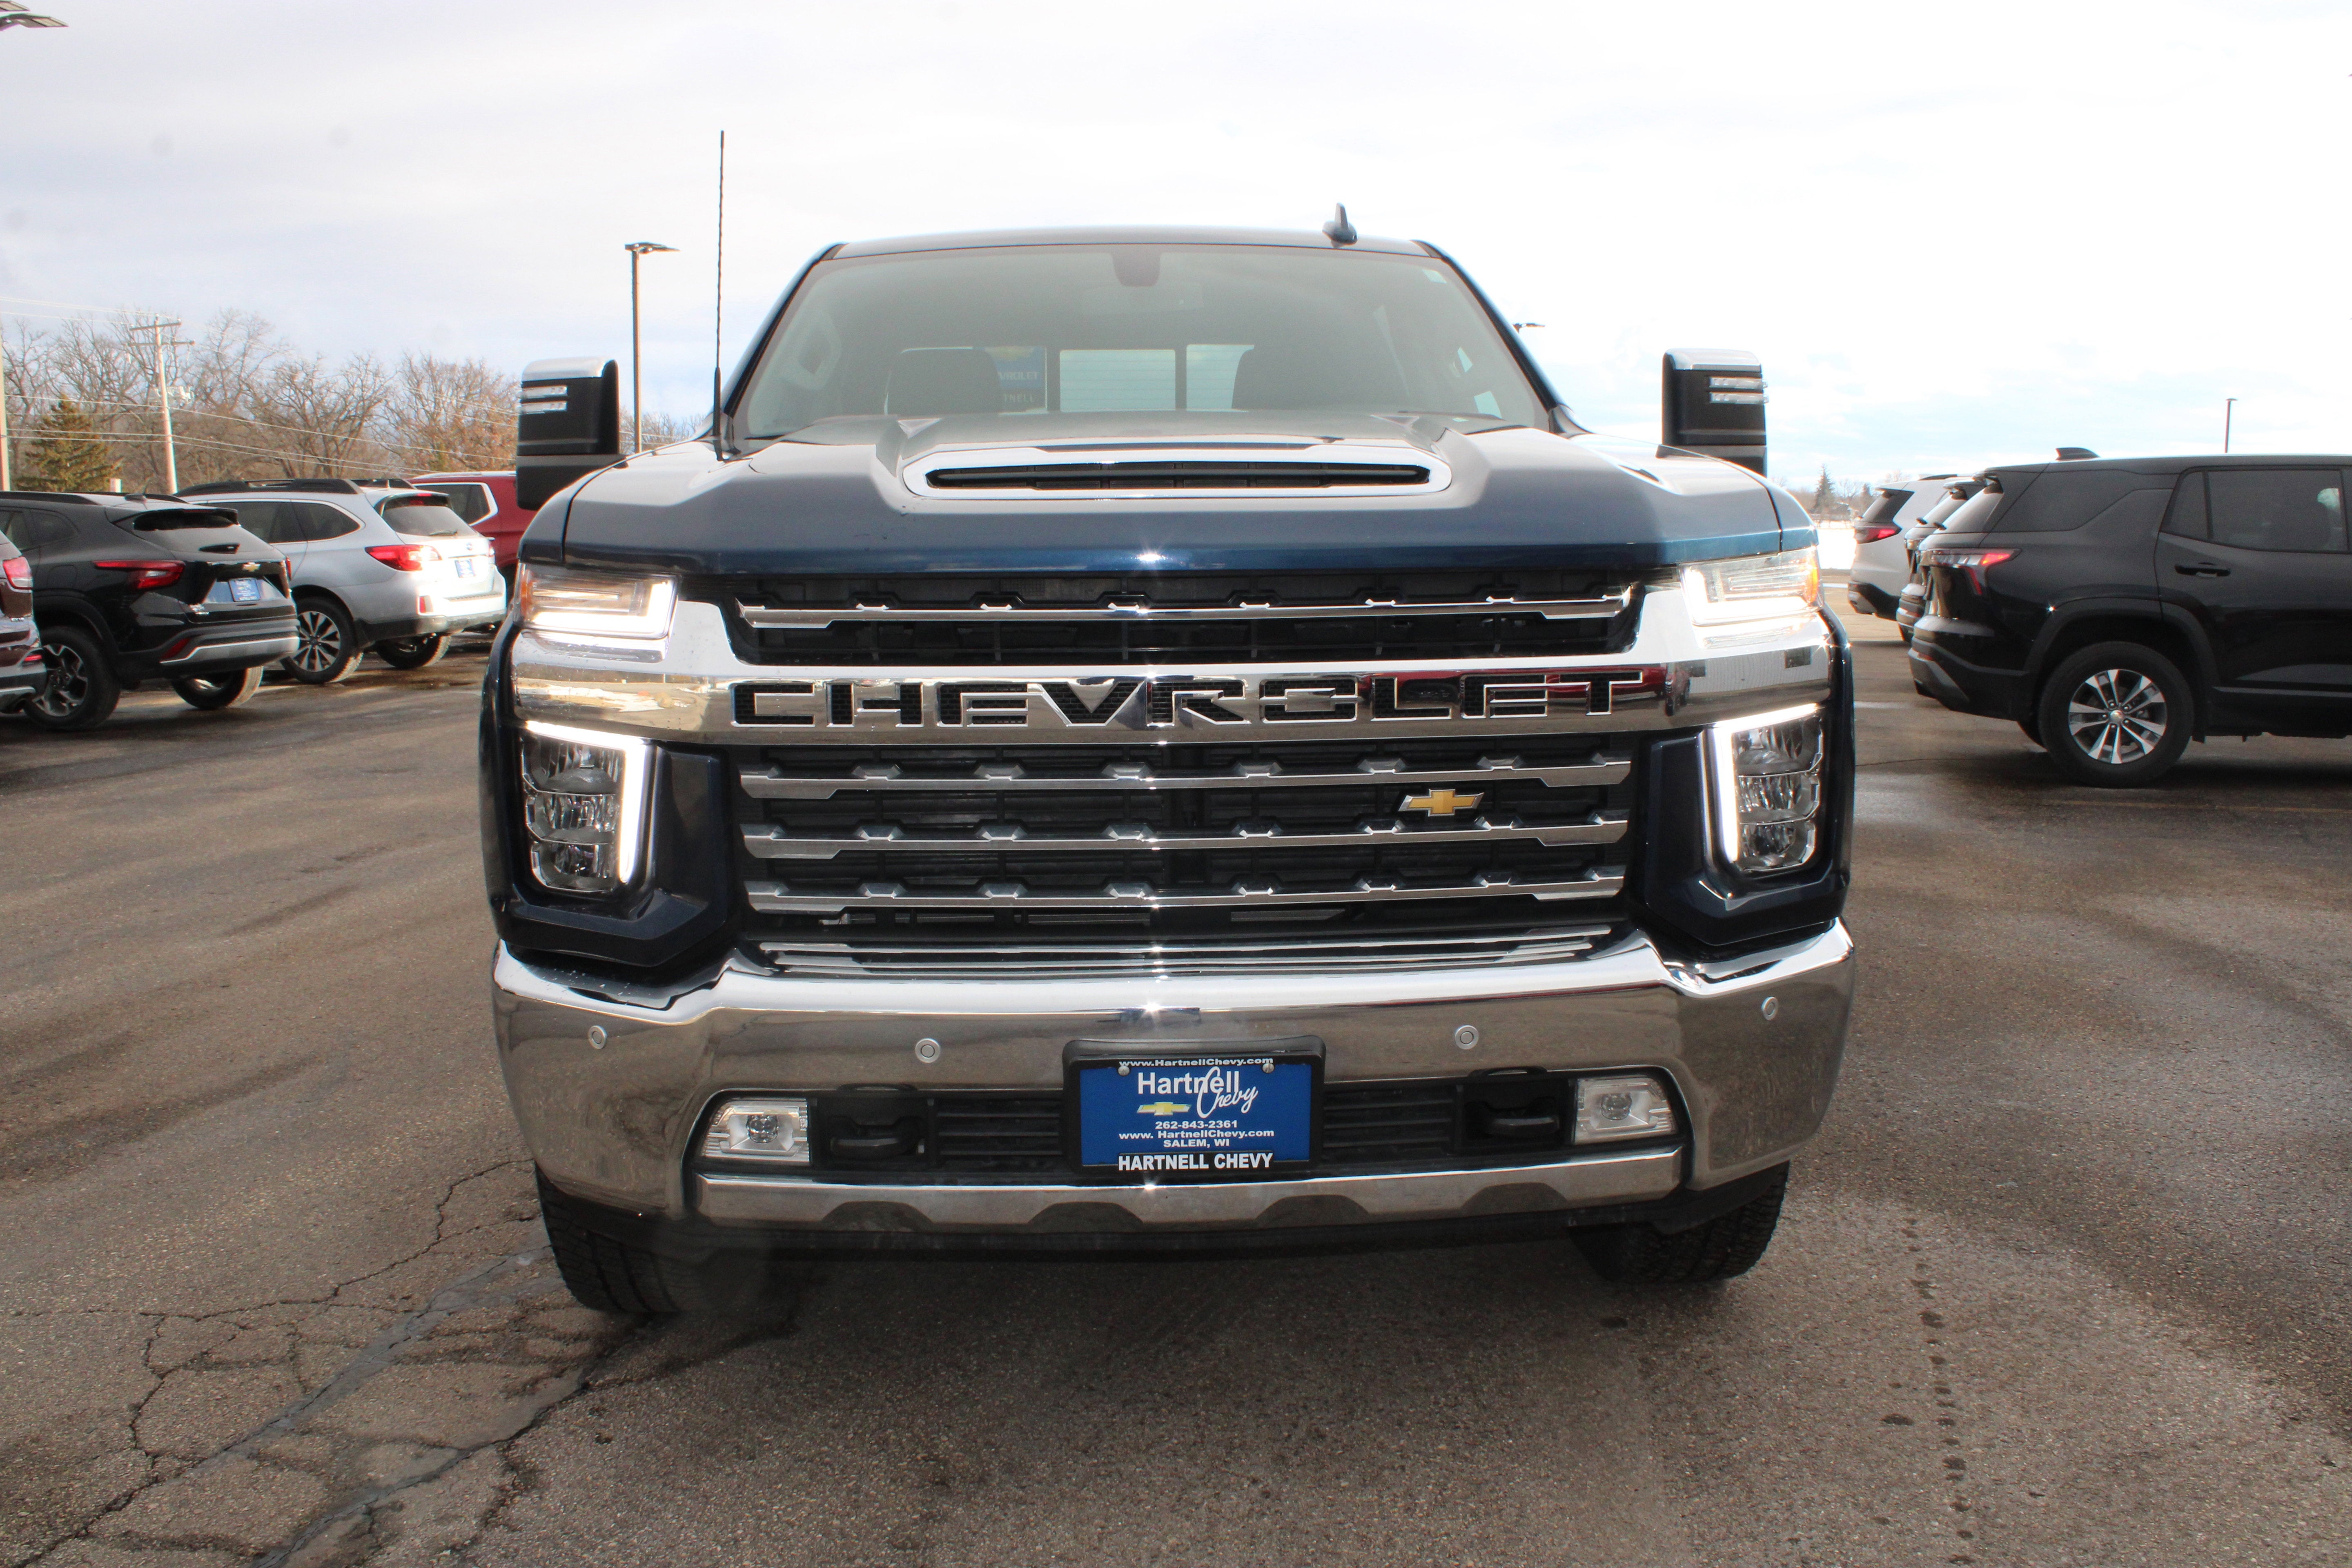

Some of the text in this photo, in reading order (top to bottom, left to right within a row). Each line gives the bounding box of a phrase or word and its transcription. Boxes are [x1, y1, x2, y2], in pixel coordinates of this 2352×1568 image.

[997, 372, 1038, 380] VROLET
[1003, 393, 1034, 403] TNELL
[731, 671, 1643, 728] CHEVROLET
[1119, 1058, 1273, 1067] www.HartnellChevy.com
[1138, 1071, 1239, 1094] Hartnell
[1196, 1066, 1259, 1118] Chevy
[1155, 1120, 1238, 1129] 262-843-2361
[1163, 1139, 1210, 1148] SALEM,
[1118, 1152, 1273, 1171] HARTNELL CHEVY
